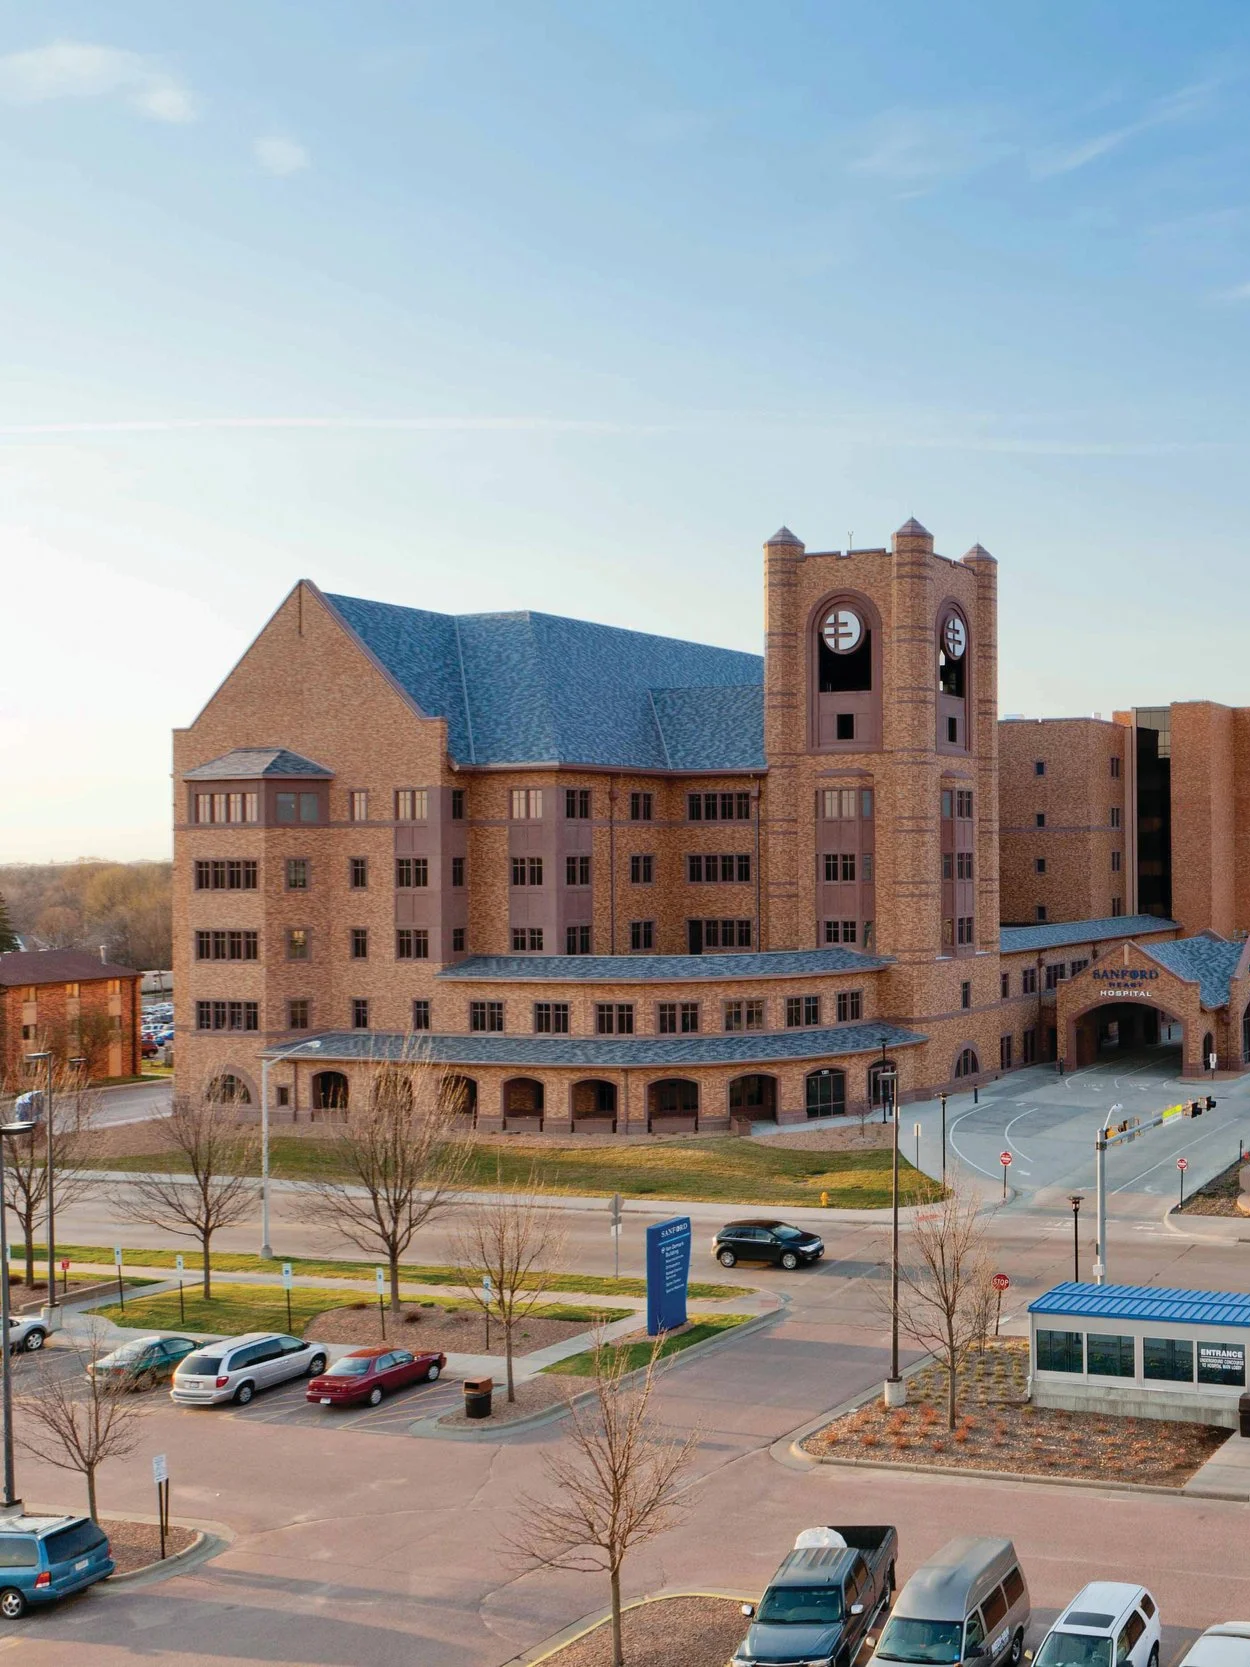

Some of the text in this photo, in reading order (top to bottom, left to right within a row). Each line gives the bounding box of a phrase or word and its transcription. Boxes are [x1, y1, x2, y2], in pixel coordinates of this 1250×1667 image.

[1093, 968, 1159, 980] SANFORD
[661, 1223, 687, 1238] SANFORD
[992, 1278, 1009, 1287] STOP
[1200, 1348, 1243, 1358] ENTRANCE
